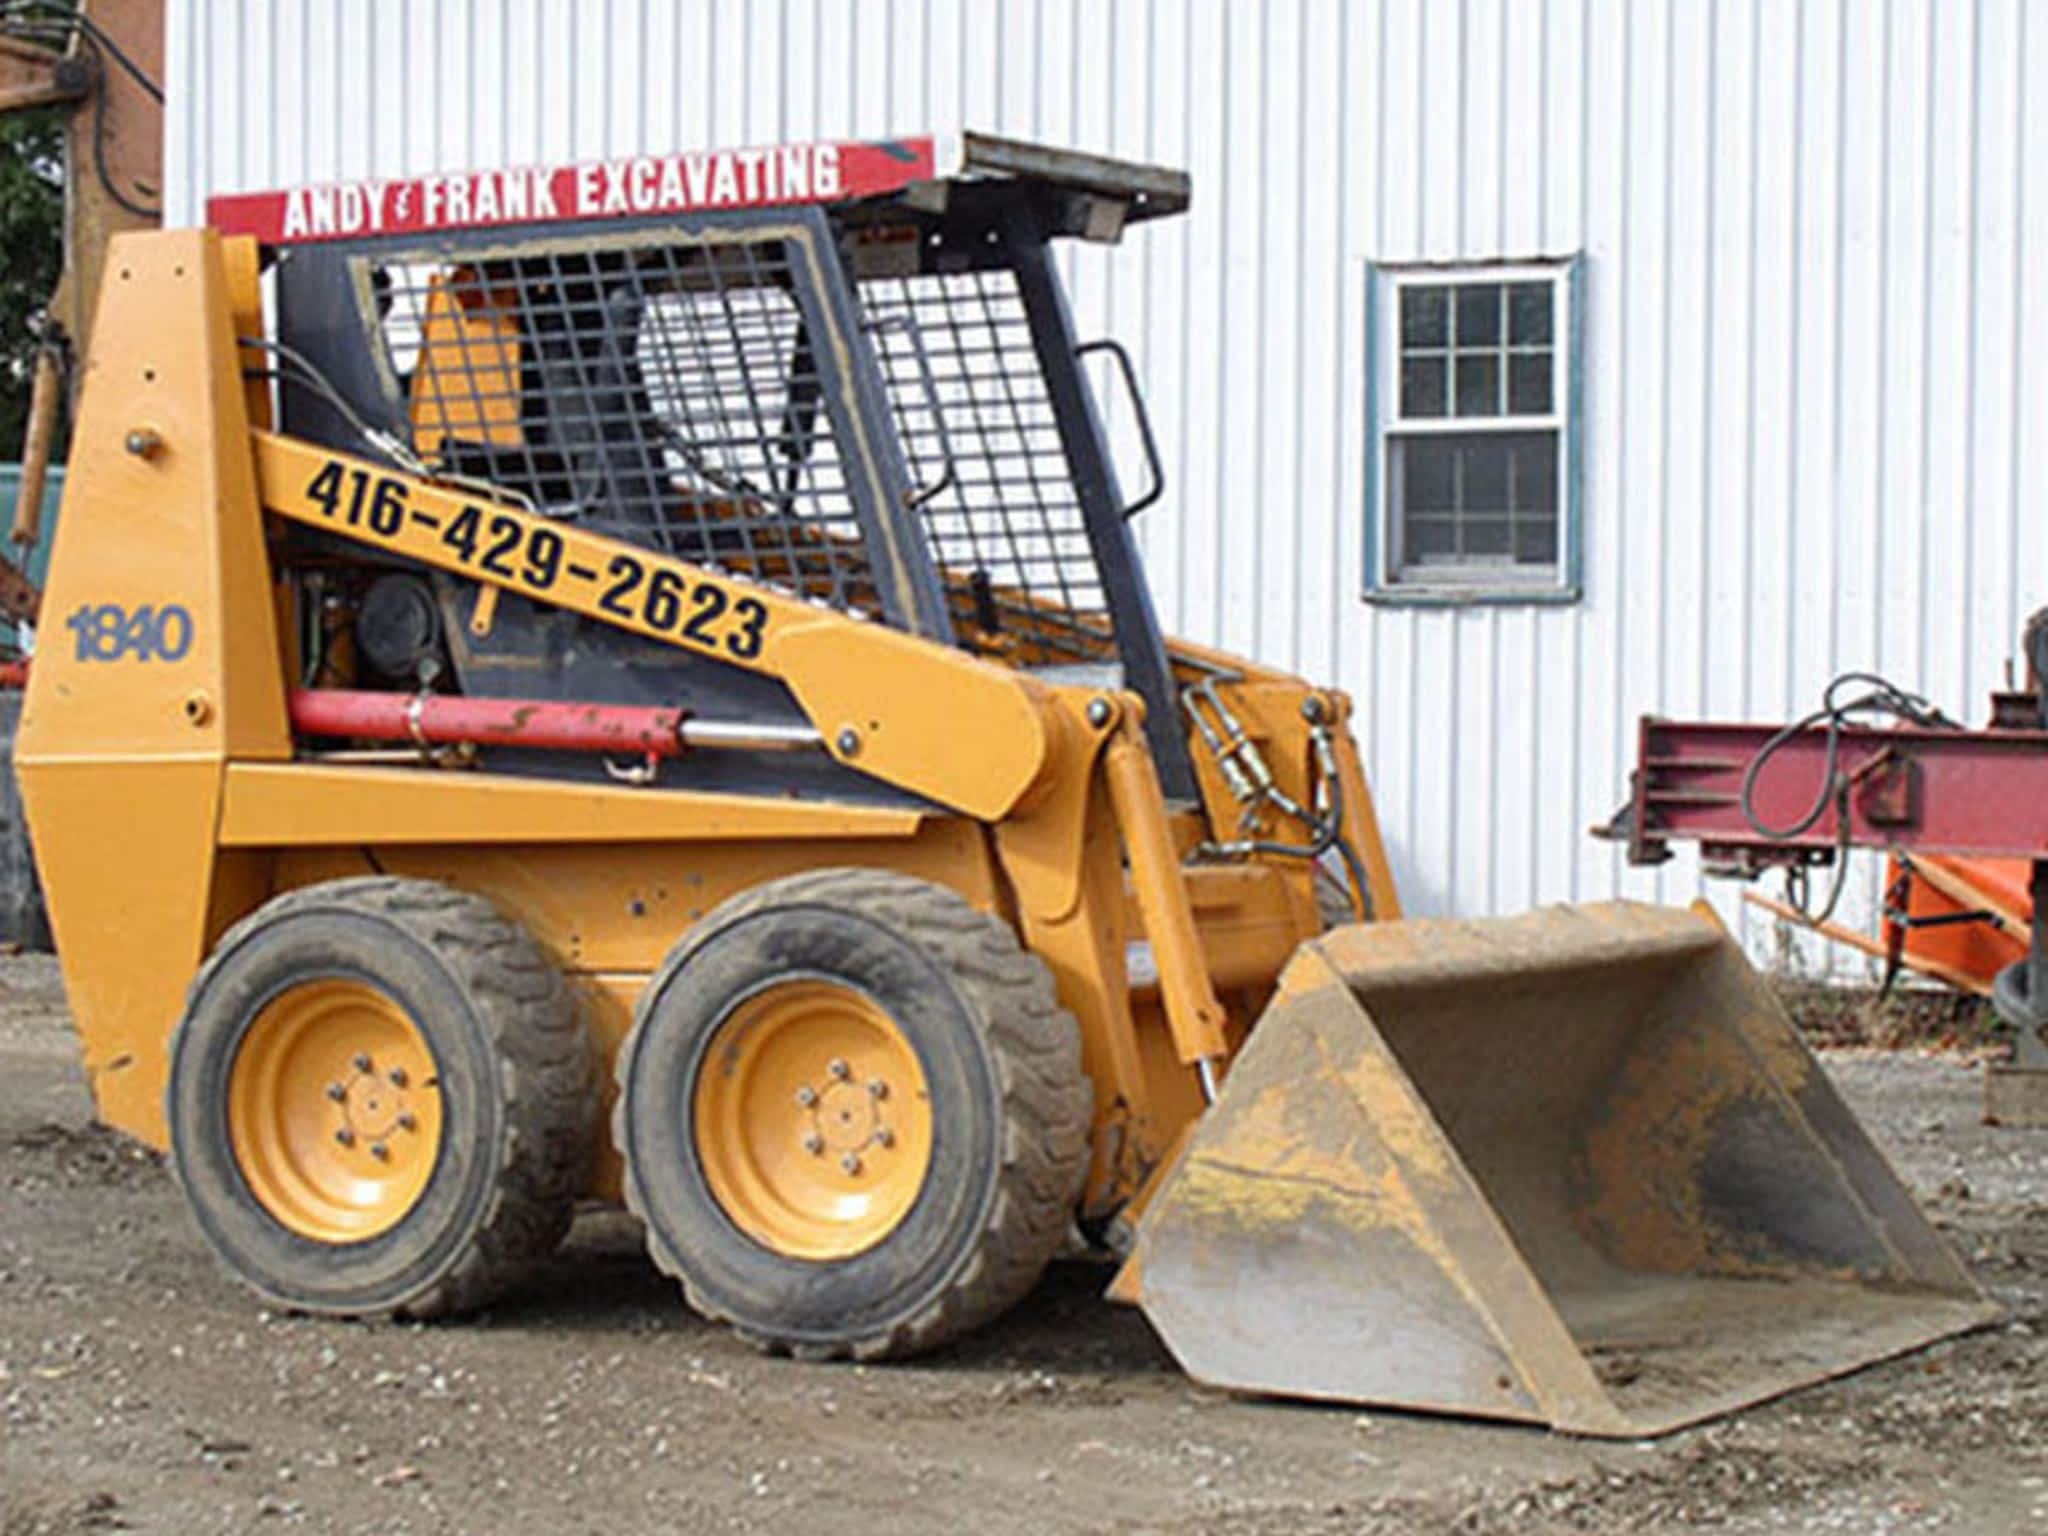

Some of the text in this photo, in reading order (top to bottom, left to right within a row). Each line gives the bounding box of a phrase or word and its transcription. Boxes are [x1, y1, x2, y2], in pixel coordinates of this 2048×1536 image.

[284, 183, 386, 238] ANDY
[423, 169, 558, 226] FRANK
[577, 145, 840, 216] EXCAVATING
[306, 461, 769, 659] 416-429-2623
[66, 604, 194, 662] 1840
